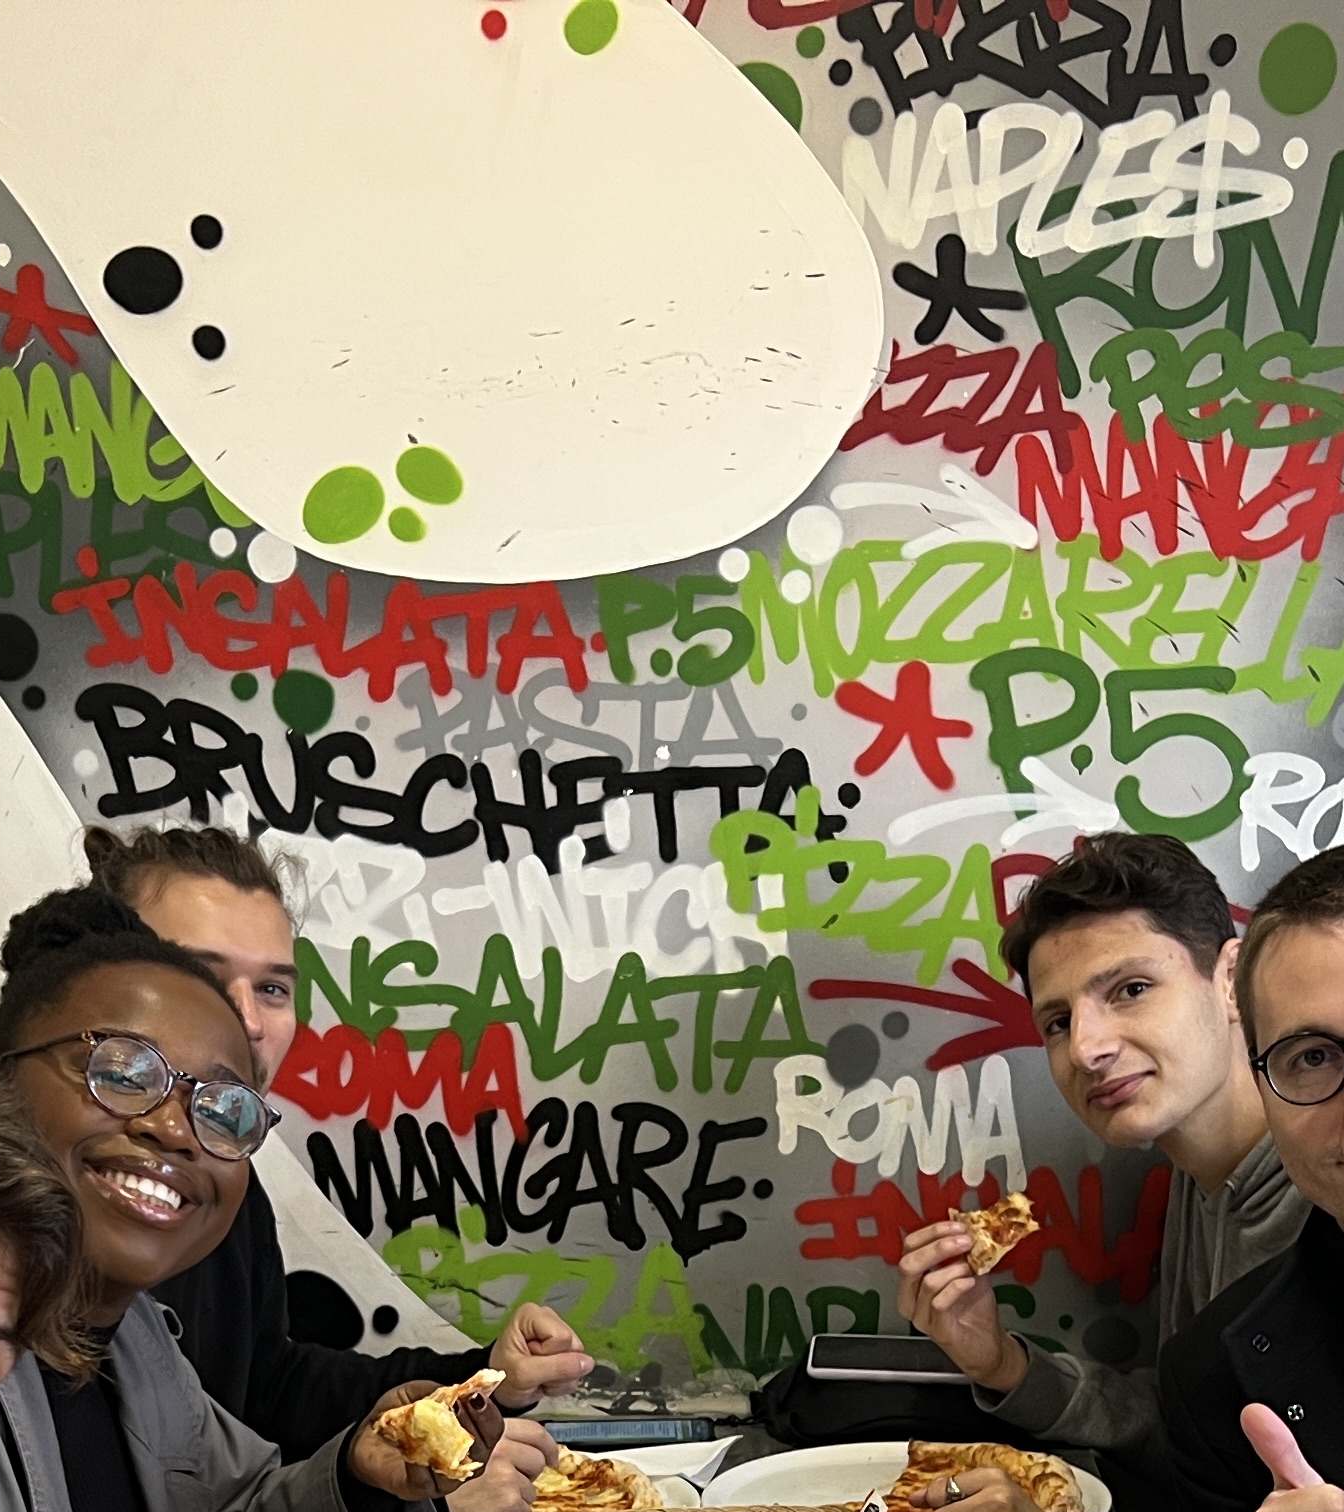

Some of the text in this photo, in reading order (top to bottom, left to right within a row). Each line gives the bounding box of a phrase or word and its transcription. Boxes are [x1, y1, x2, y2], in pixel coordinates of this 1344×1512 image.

[594, 574, 756, 687] P.5
[394, 665, 784, 778] PASTA
[968, 647, 1252, 843] P.5
[709, 784, 1014, 986] PIZZA
[774, 1054, 1029, 1192] ROMA
